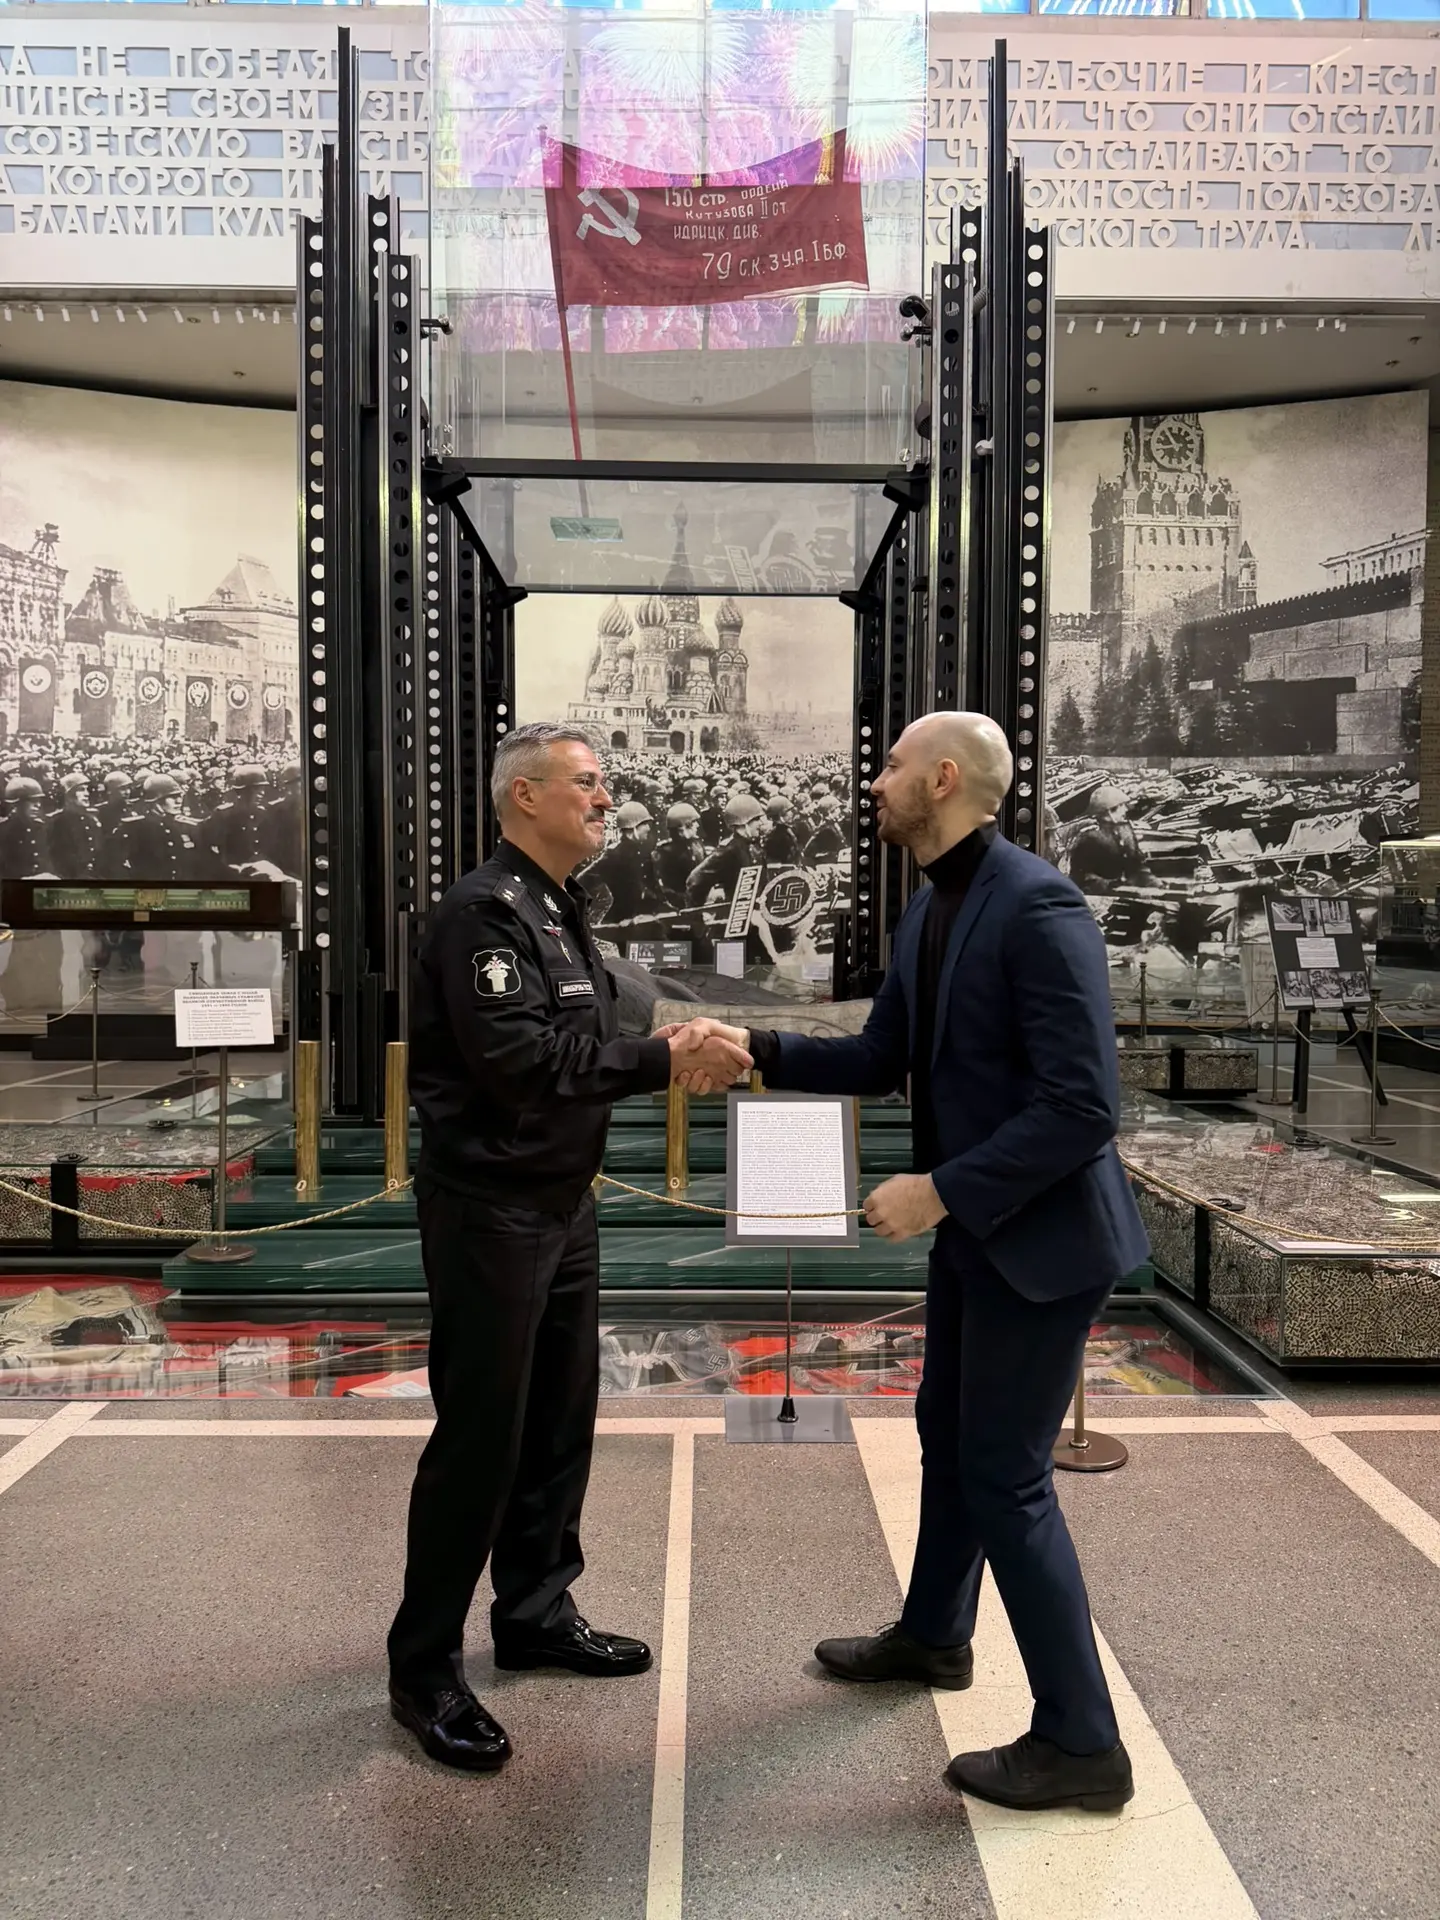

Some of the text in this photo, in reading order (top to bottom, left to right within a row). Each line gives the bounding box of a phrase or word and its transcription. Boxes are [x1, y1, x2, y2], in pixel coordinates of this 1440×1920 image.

[77, 47, 126, 76] НЕ
[170, 48, 338, 80] ПОБЕДЯ
[1020, 61, 1204, 92] РАБОЧИЕ
[1247, 65, 1267, 94] И
[1310, 65, 1440, 96] КРЕСТ
[191, 88, 319, 119] СВОЕМ
[1083, 101, 1154, 131] ЧТО
[1185, 103, 1263, 133] ОНИ
[4, 126, 428, 162] СОВЕТСКУЮ ВЛСТЬ
[1056, 141, 1312, 173] ОТСТАИВАЮТ
[1342, 144, 1392, 174] ТО
[44, 166, 250, 197] КОТОРОГО
[665, 188, 693, 207] 150
[15, 205, 183, 236] БЛАГАМИ
[733, 224, 762, 240] ДИВ.
[1197, 221, 1316, 250] ТРУДА.
[702, 252, 732, 279] 79
